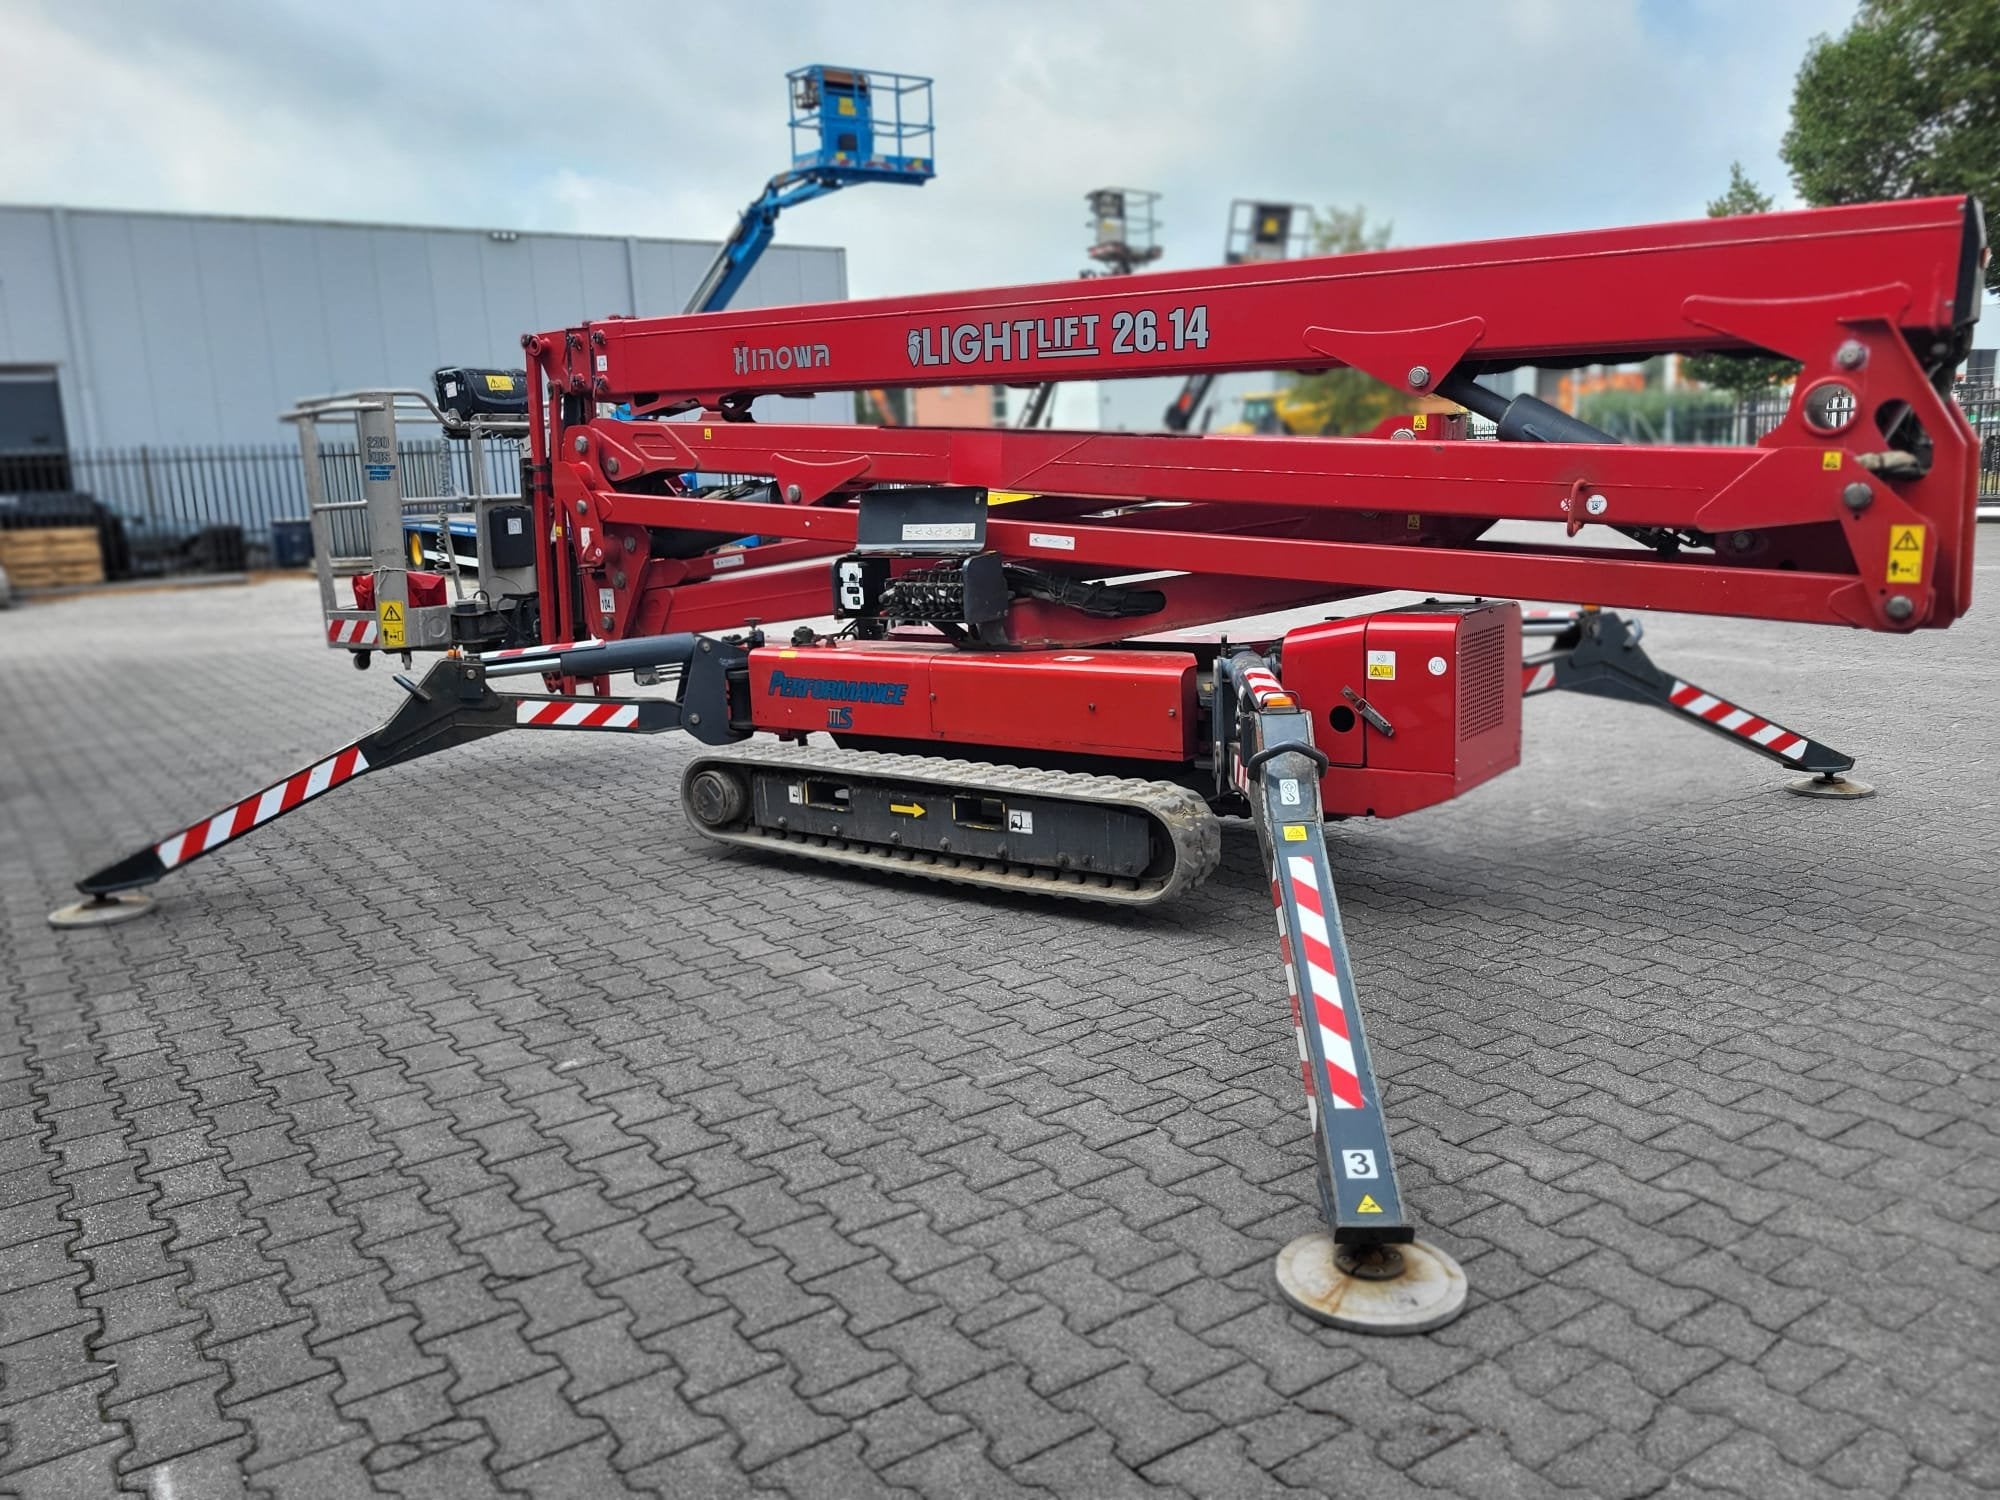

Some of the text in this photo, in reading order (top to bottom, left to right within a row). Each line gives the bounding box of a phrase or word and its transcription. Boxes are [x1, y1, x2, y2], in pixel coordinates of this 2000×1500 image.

[1112, 306, 1209, 354] 26.14
[768, 670, 909, 705] PERFORMANCE
[1350, 1152, 1371, 1175] 3
